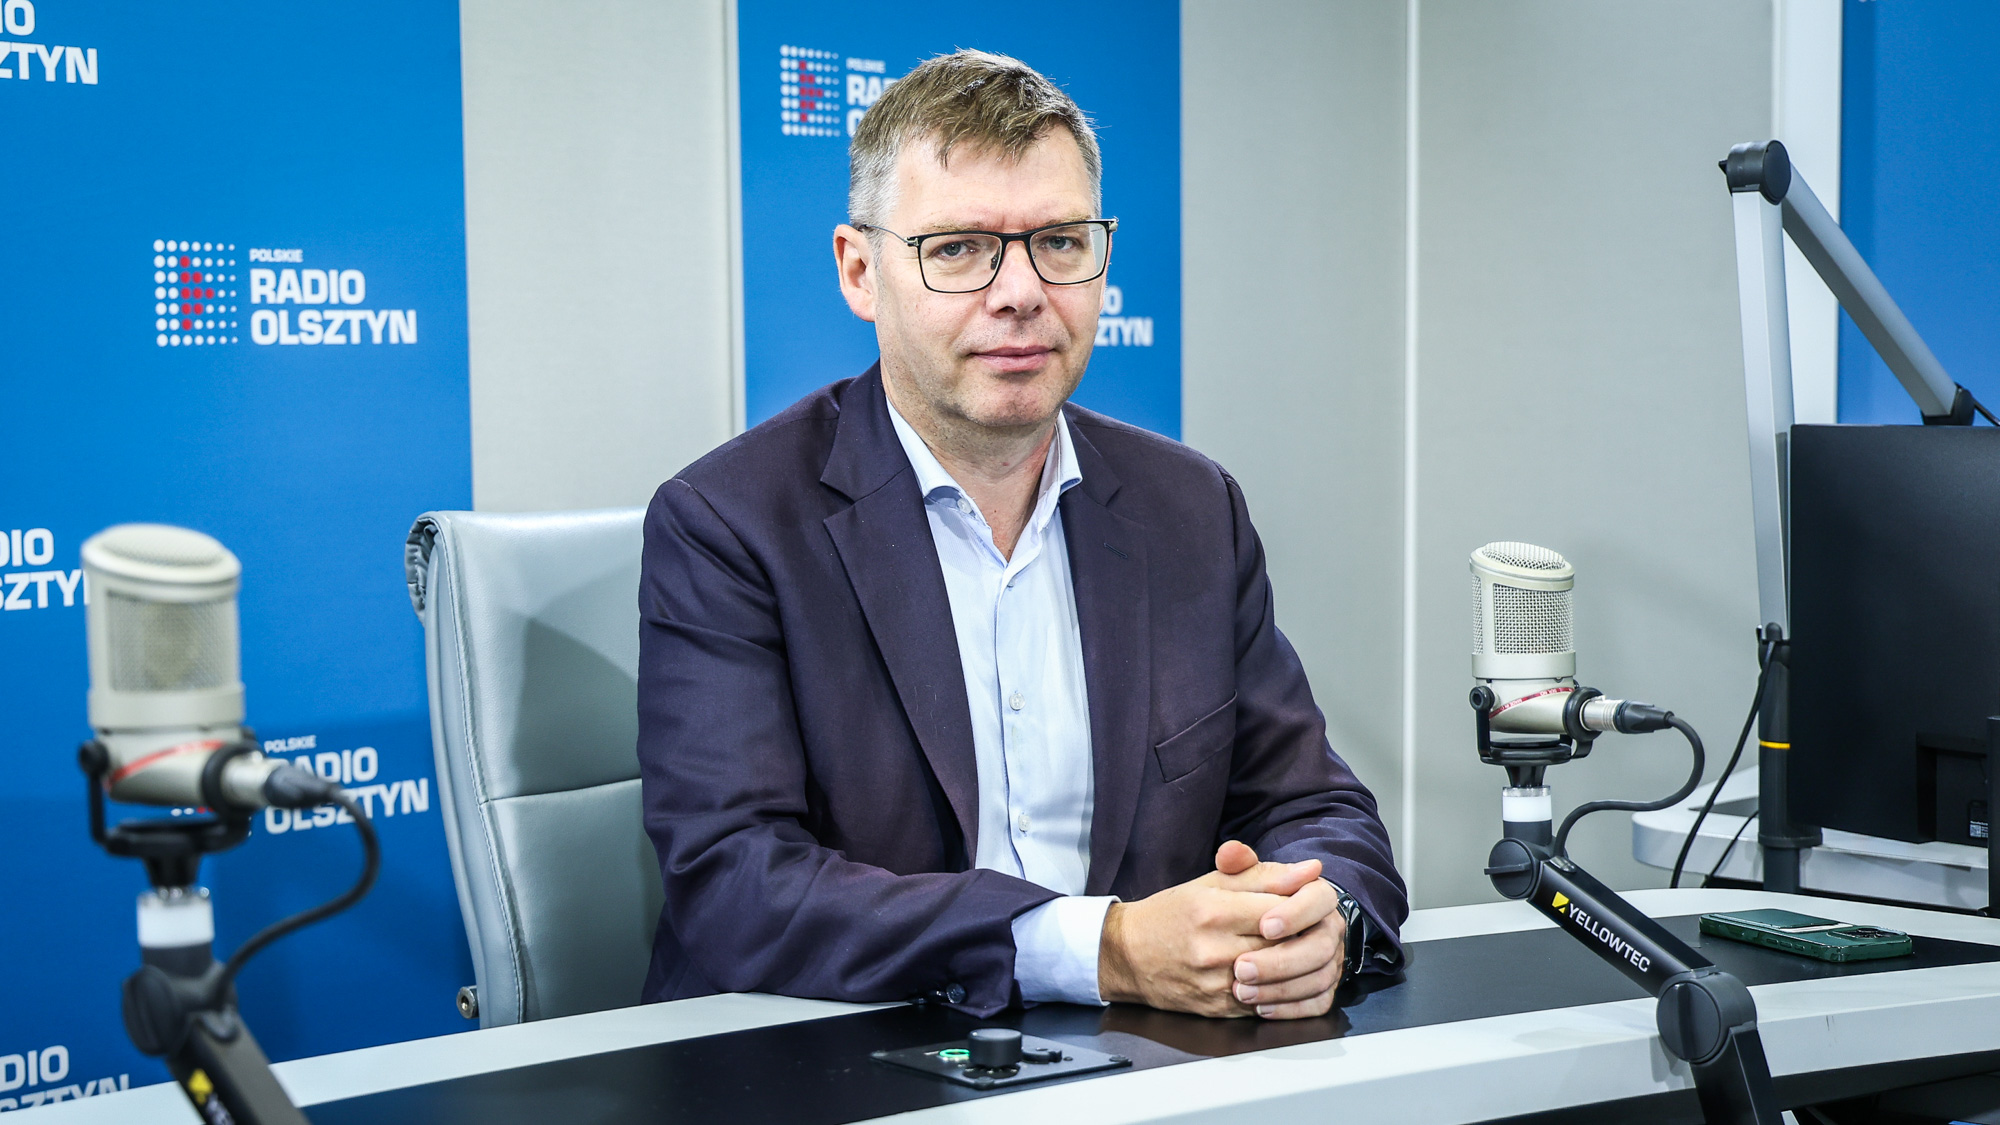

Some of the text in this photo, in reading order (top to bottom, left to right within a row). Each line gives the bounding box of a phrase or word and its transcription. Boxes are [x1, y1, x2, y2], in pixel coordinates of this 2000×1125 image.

[250, 249, 303, 263] POLSKIE
[250, 268, 366, 304] RADIO
[1100, 285, 1123, 315] O
[251, 309, 417, 345] OLSZTYN
[0, 569, 90, 611] ZTY
[264, 735, 316, 753] POLSKIE
[1569, 903, 1650, 972] YELLOWTEC
